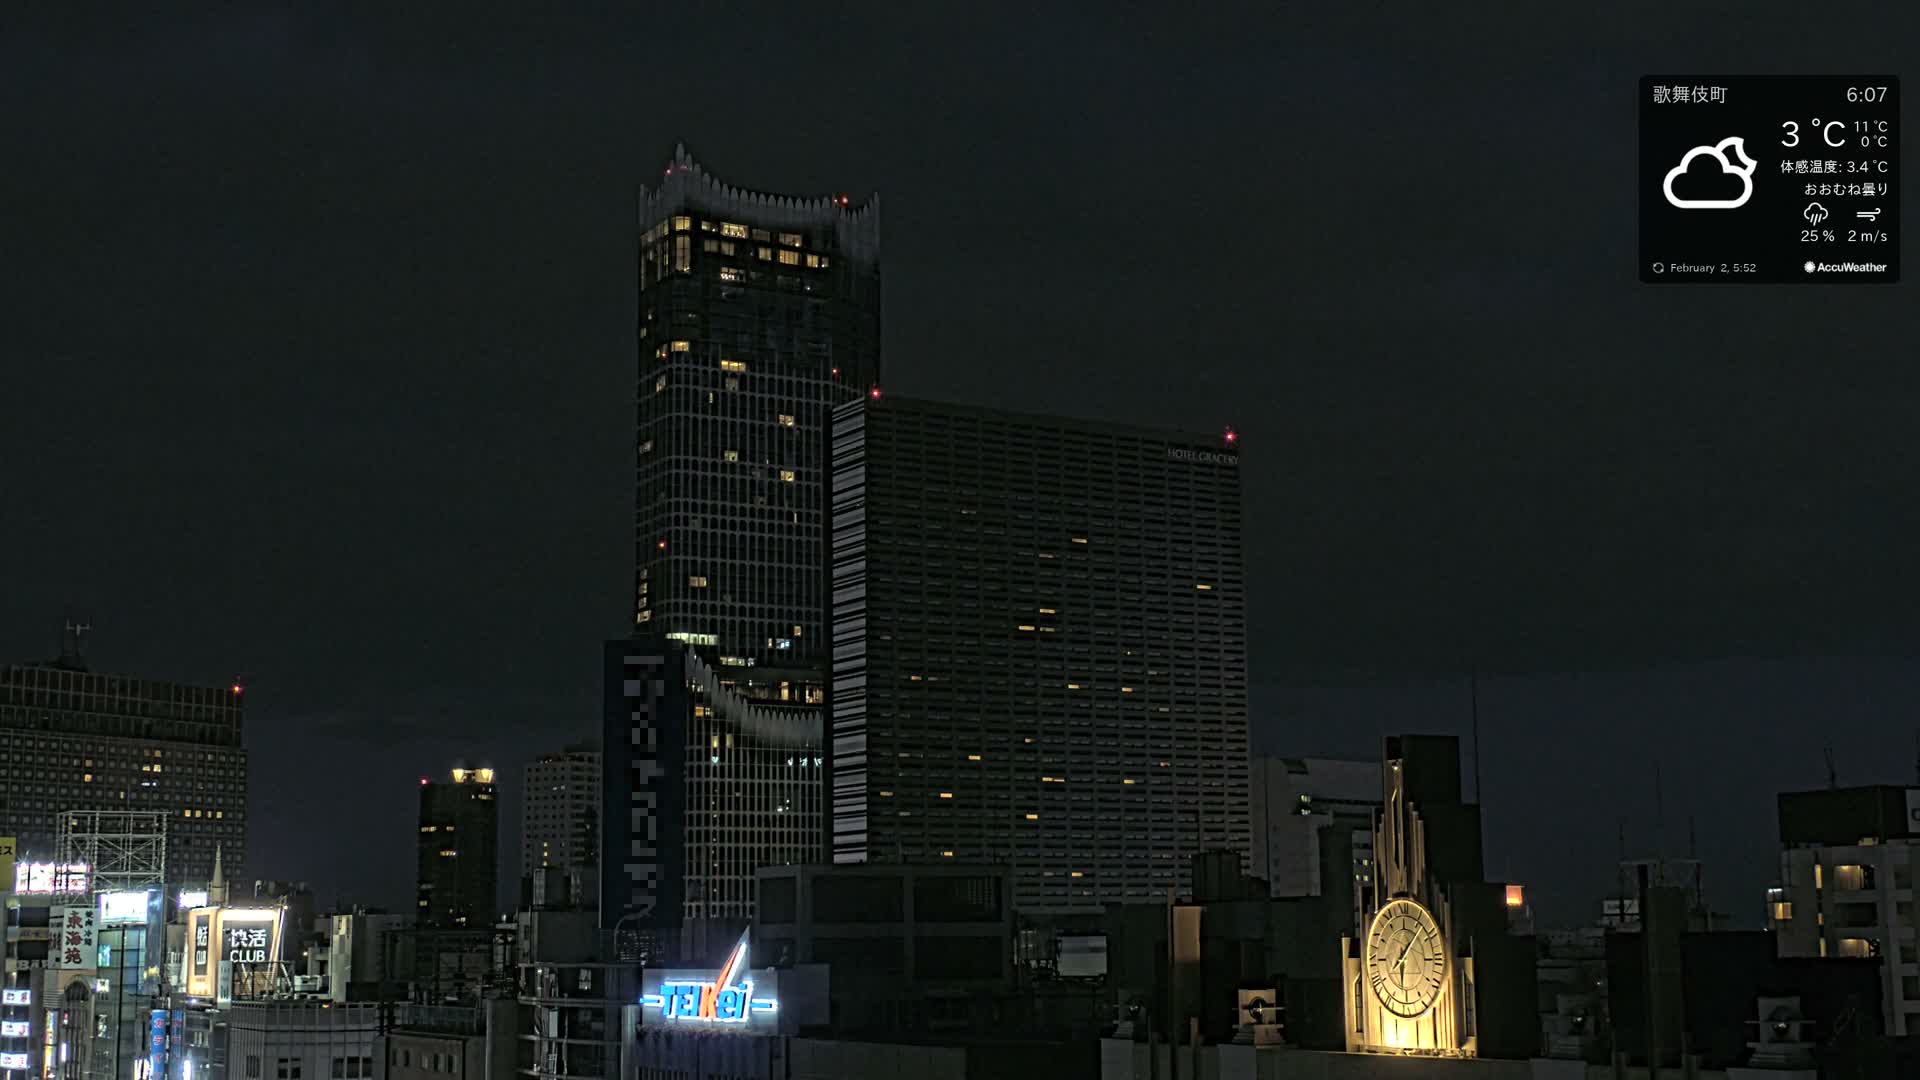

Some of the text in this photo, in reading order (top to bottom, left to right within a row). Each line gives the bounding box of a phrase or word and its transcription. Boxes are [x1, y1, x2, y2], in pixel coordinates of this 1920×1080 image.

[1167, 448, 1239, 465] HOTEL GRACERY
[64, 910, 83, 964] 東海苑
[230, 928, 267, 947] 快活
[230, 950, 266, 963] CLUB
